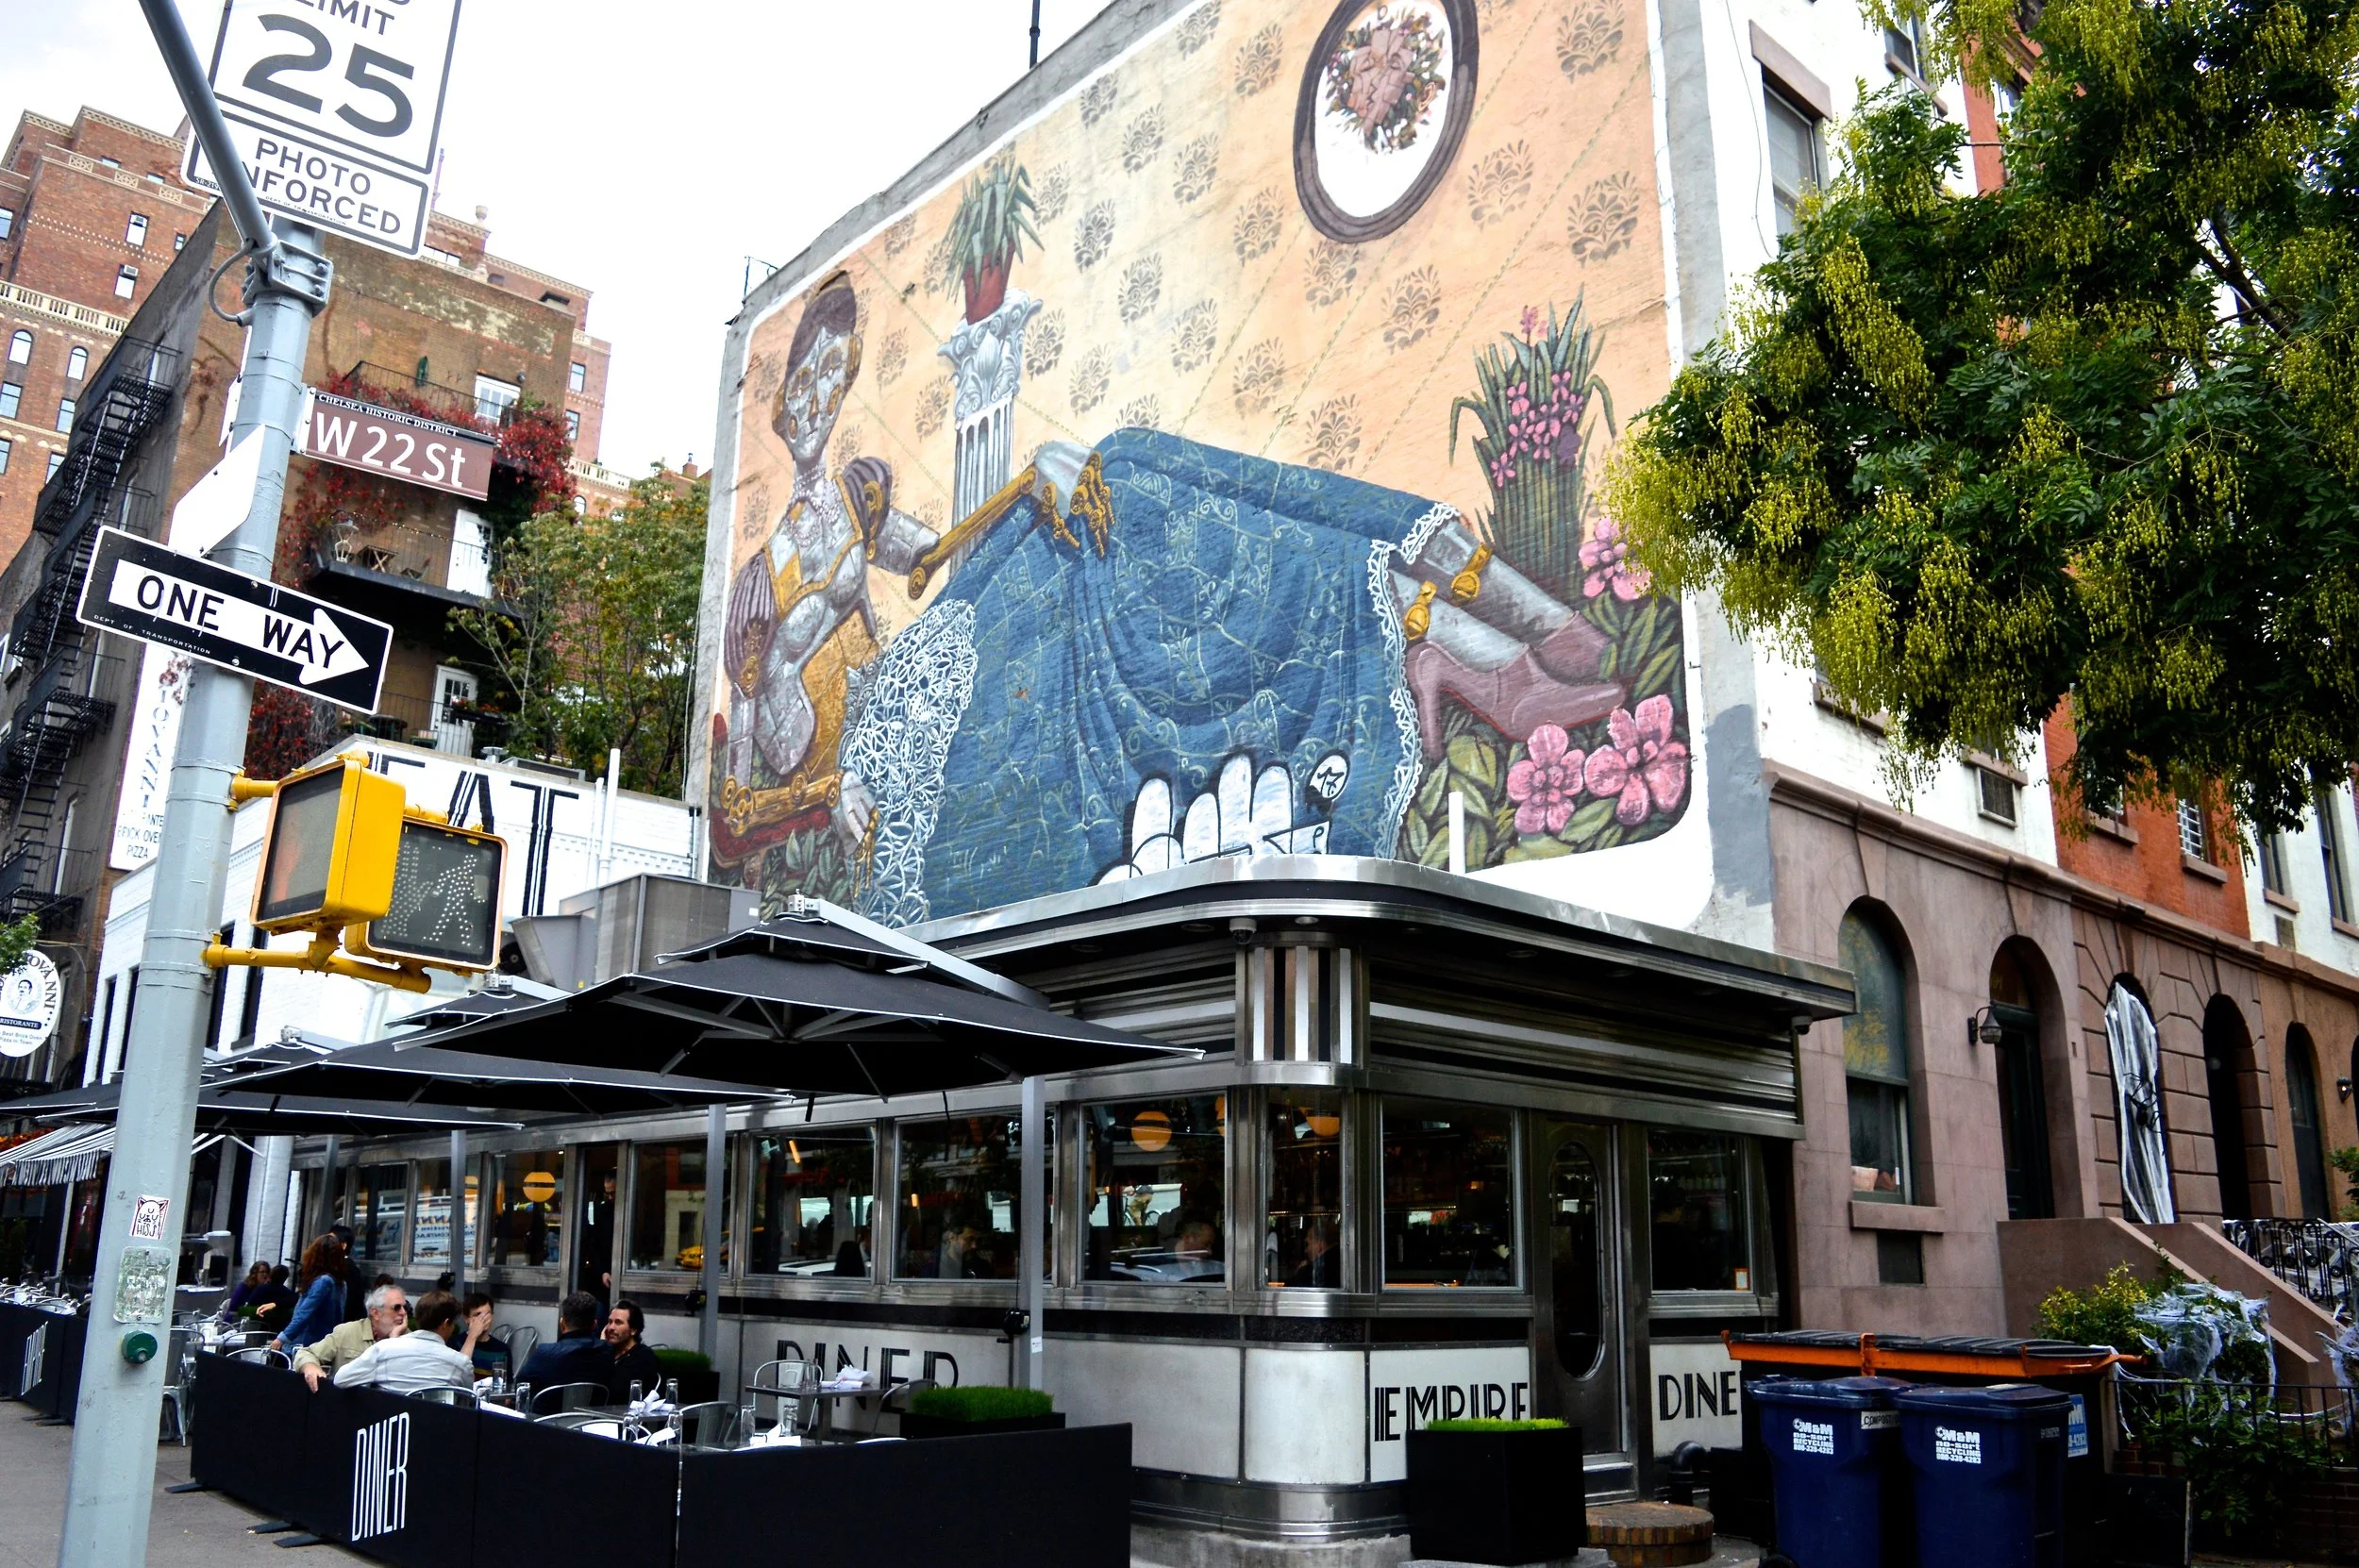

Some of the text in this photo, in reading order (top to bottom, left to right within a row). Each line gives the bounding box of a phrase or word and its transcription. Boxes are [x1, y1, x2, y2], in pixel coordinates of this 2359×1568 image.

[243, 13, 414, 138] 25
[255, 137, 371, 195] PHOTO
[242, 160, 401, 234] NFORCED
[318, 394, 459, 438] CHELSEA HISTORIC DISTRICT
[316, 411, 466, 488] W 22 St
[93, 614, 211, 655] DEPT OF TRANSPORTATION
[137, 575, 344, 669] ONE WAY
[140, 690, 170, 808] IOVANNI
[367, 751, 579, 916] AT
[1375, 1382, 1528, 1442] EMPIRE
[1659, 1371, 1742, 1421] DINE
[1793, 1438, 1834, 1448] RECYCLING
[1799, 1421, 1833, 1435] M&M
[1936, 1446, 1982, 1458] RECYCLING
[1942, 1429, 1981, 1444] M&M
[351, 1411, 410, 1542] DINER
